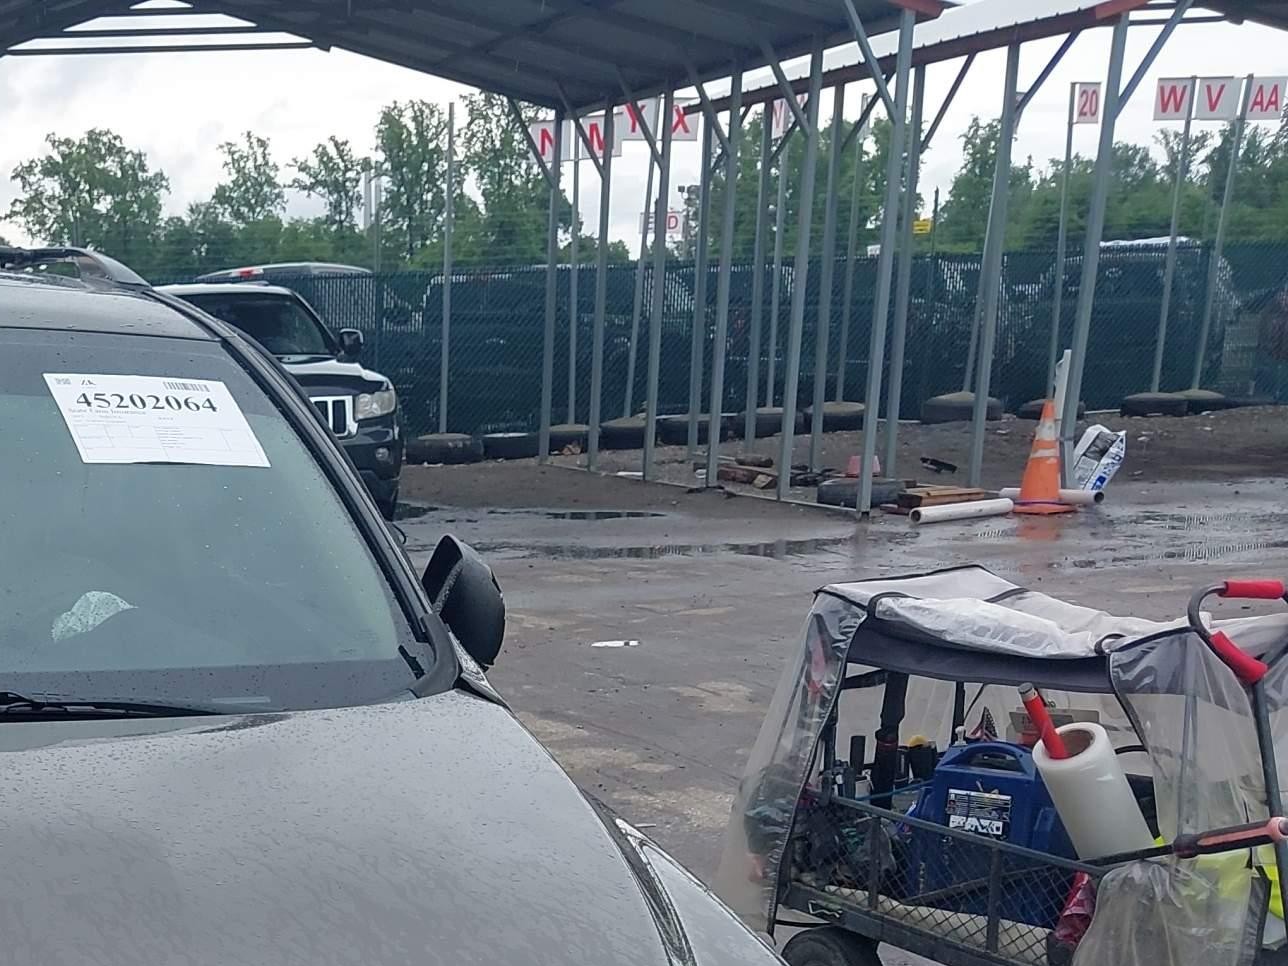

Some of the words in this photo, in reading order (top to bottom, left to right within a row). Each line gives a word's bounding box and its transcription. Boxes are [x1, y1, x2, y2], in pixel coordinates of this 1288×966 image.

[1078, 89, 1099, 118] 20
[1159, 84, 1188, 113] W
[1206, 84, 1225, 112] V
[1249, 84, 1280, 113] AA
[625, 102, 646, 134] Y
[672, 104, 690, 134] X
[667, 215, 679, 230] D
[76, 393, 217, 412] 45202064
